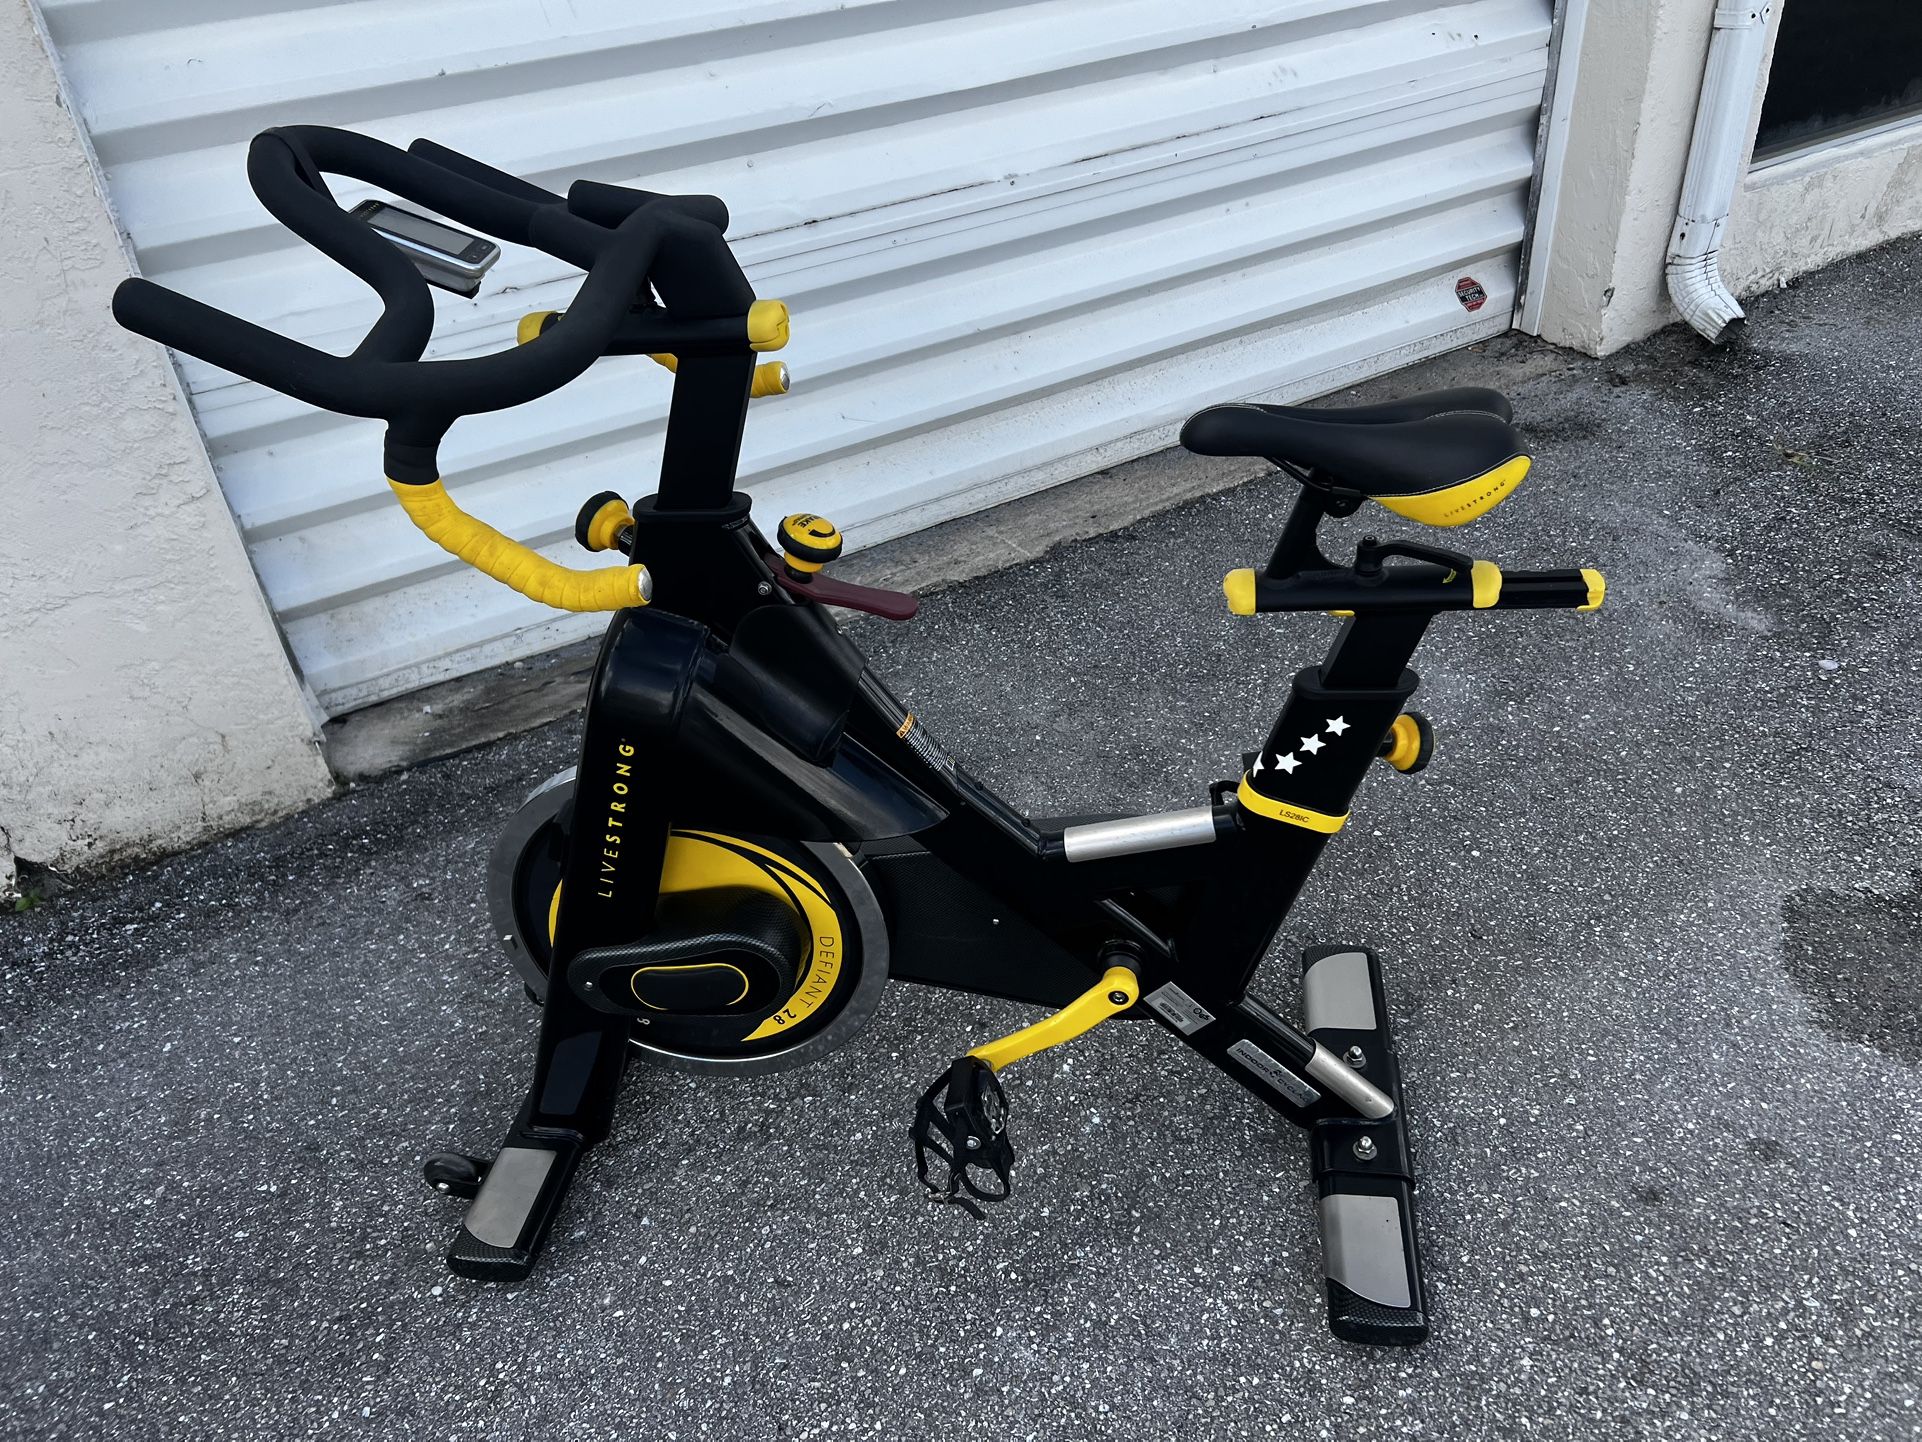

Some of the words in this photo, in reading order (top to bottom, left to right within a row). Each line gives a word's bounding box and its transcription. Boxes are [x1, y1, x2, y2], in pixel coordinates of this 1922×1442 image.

[1457, 286, 1482, 298] SECURITY
[1465, 293, 1480, 302] TECH
[1443, 480, 1506, 518] LIVESTRONG
[597, 742, 635, 899] LIVESTRONG
[1279, 809, 1310, 824] LS28IC
[799, 936, 835, 1009] DEFIANT
[772, 1007, 797, 1025] 28
[1235, 1047, 1270, 1073] INDOOR
